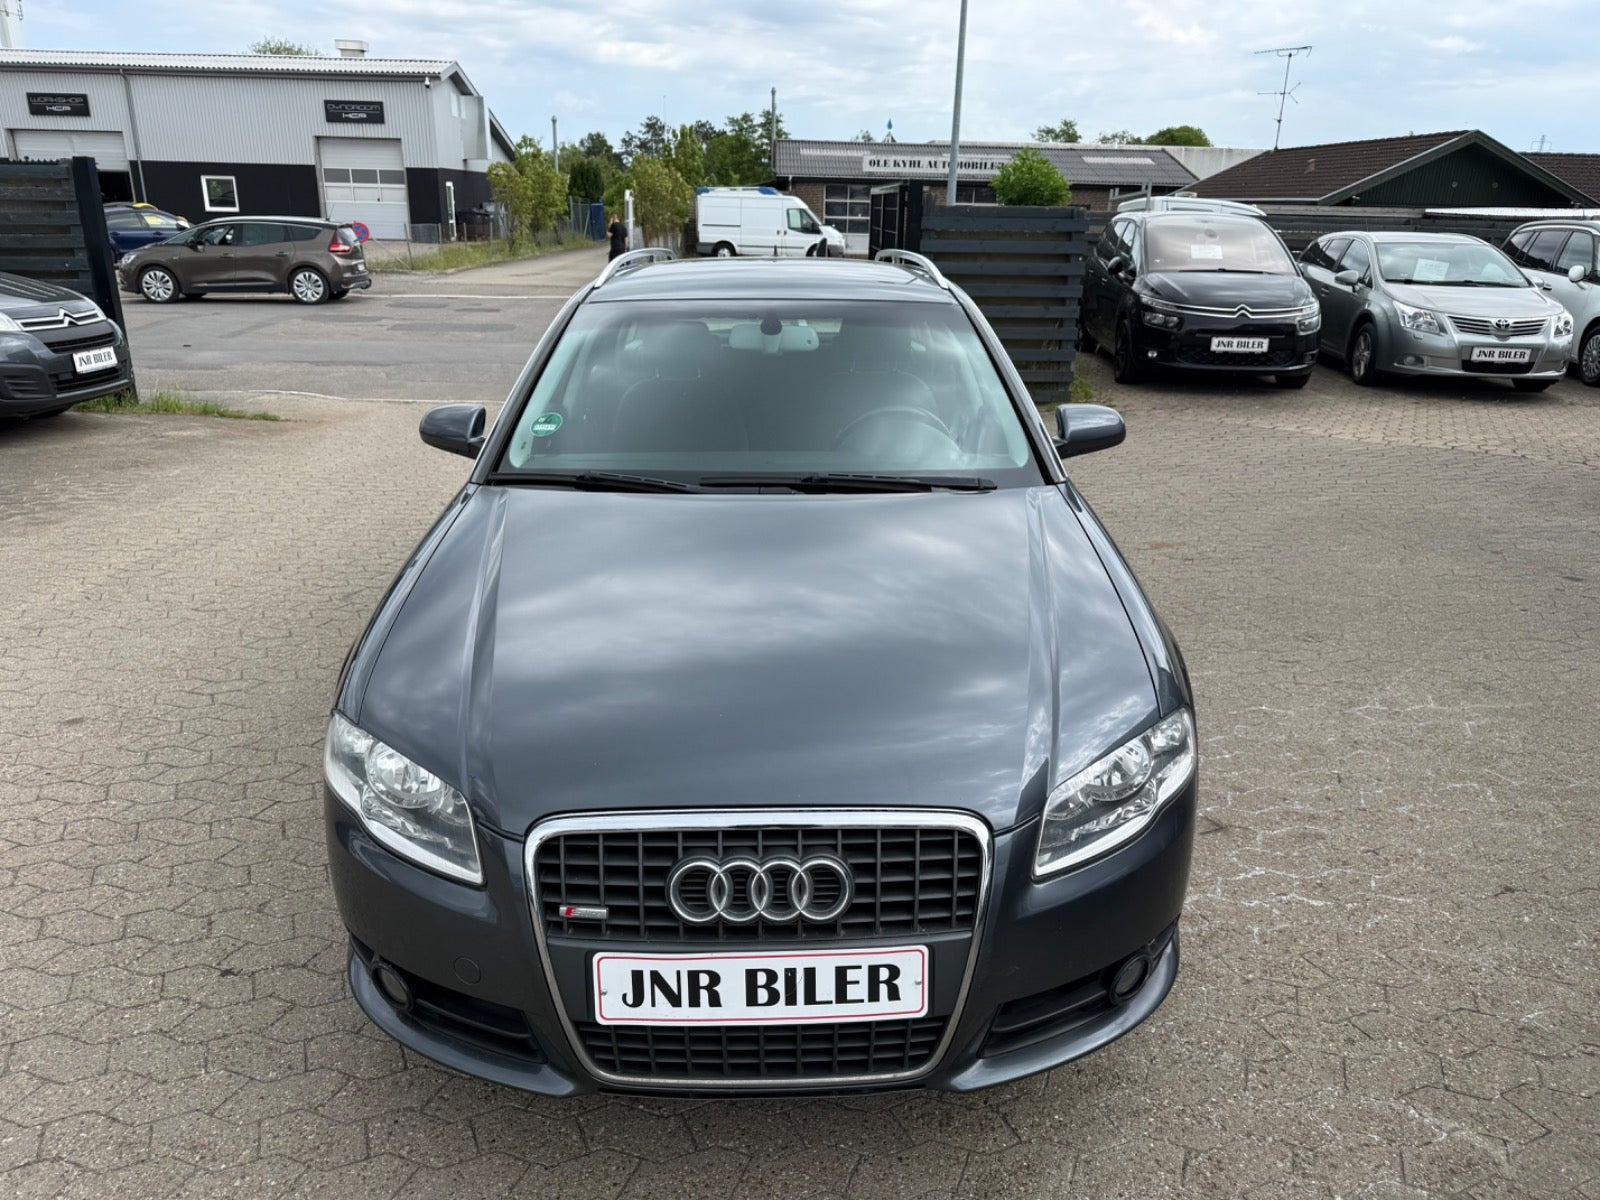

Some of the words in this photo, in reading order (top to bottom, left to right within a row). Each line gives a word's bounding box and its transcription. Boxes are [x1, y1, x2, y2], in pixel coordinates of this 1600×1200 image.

[868, 159, 890, 168] OLE
[1216, 339, 1234, 349] JNR
[1236, 340, 1264, 349] BILER
[1476, 349, 1495, 358] JNR
[1497, 350, 1526, 359] BILER
[622, 969, 722, 1008] JNR
[745, 963, 901, 1008] BILER
